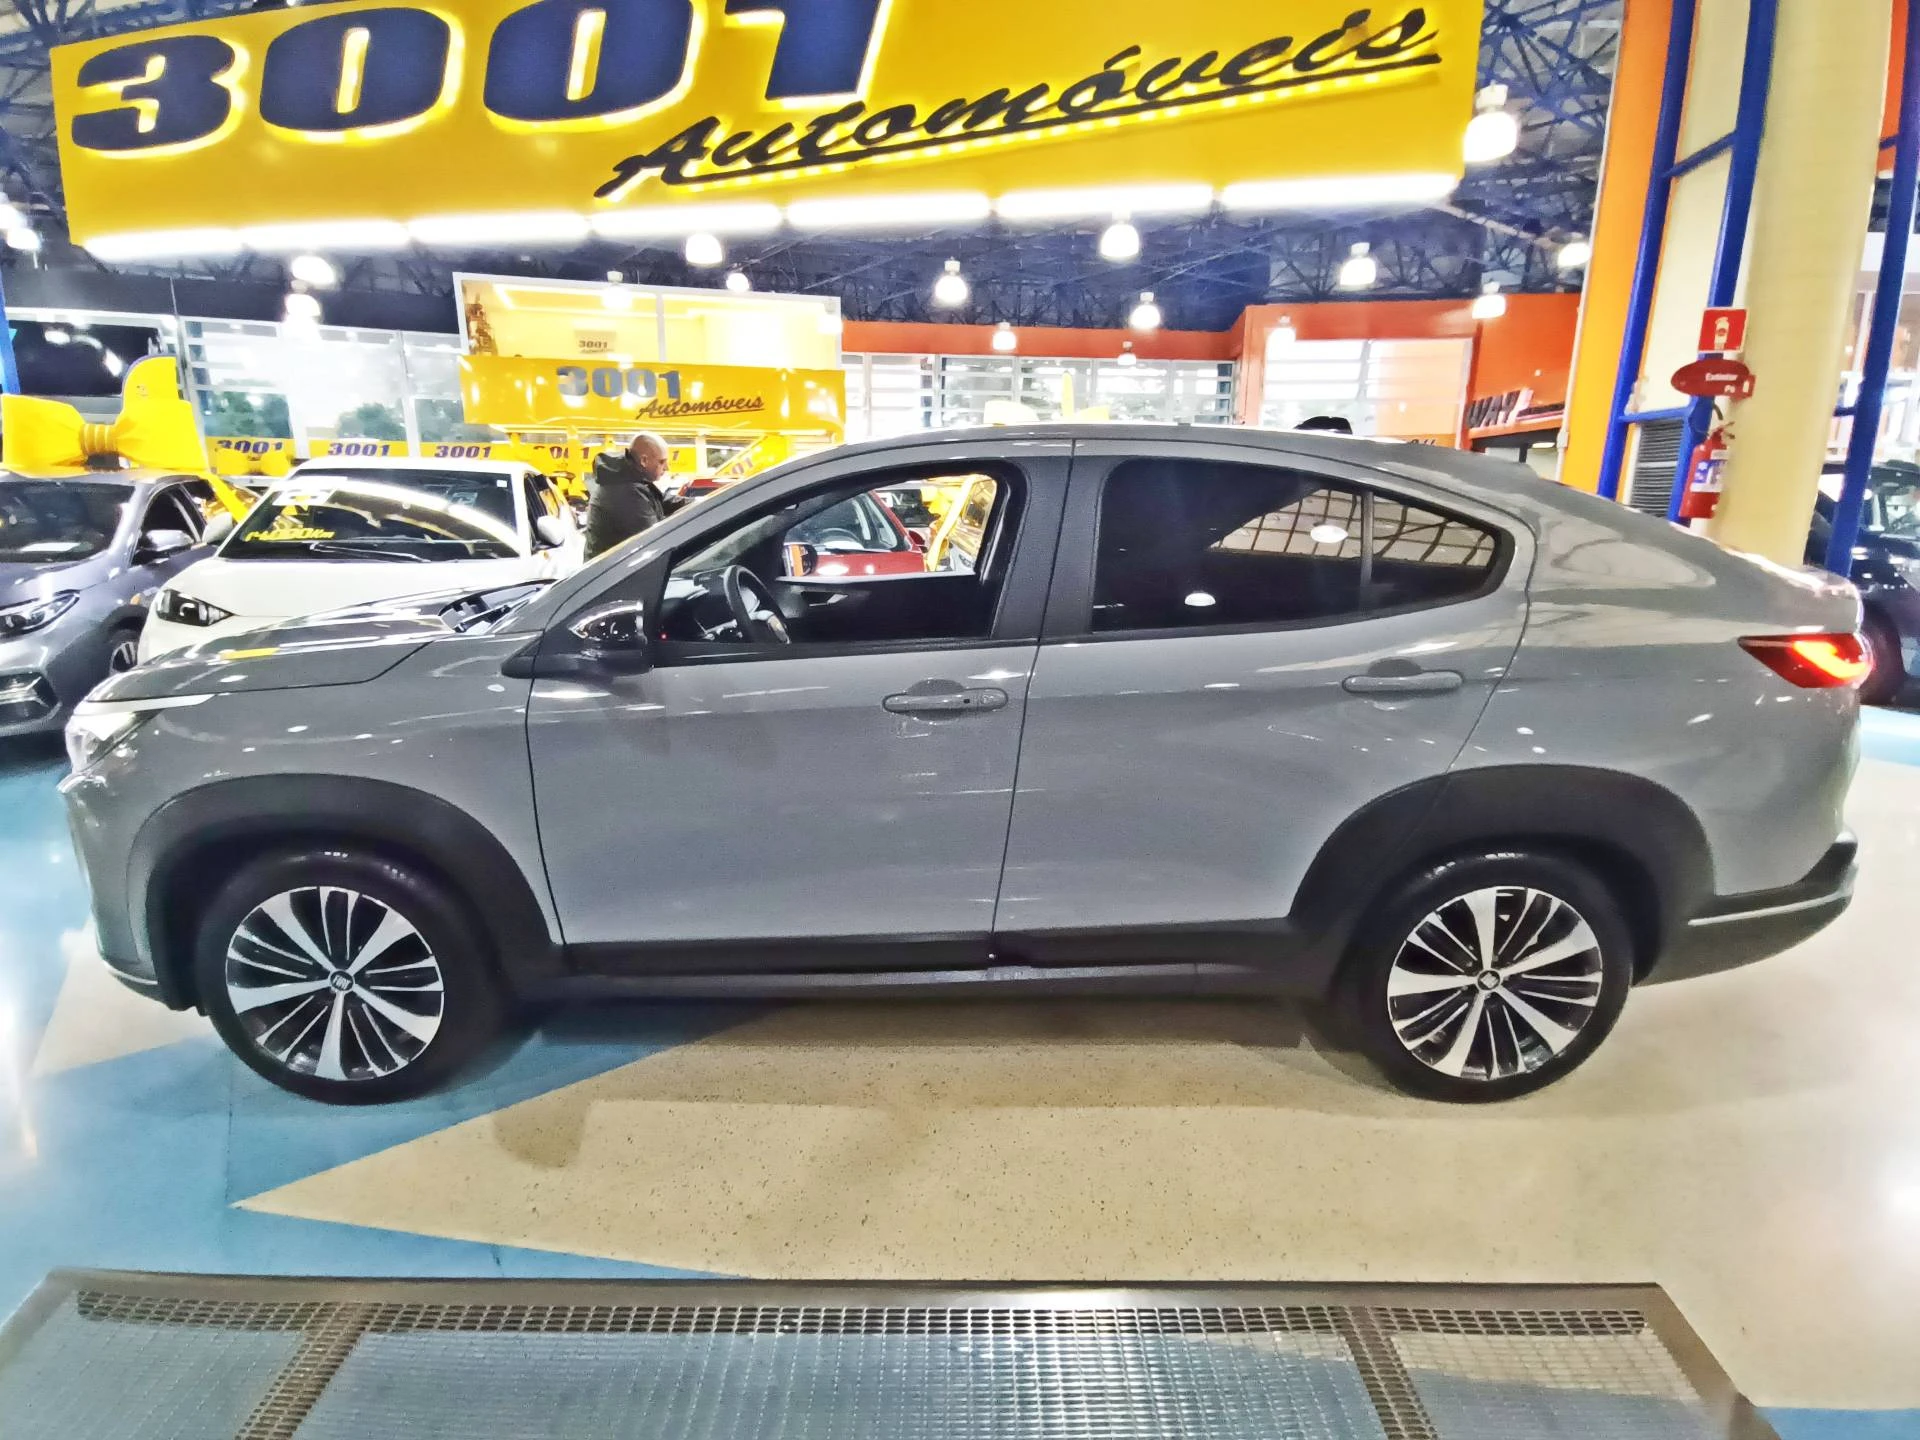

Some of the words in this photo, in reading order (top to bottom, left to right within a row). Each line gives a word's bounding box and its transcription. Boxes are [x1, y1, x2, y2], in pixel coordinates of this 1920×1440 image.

[72, 0, 883, 150] 3001
[594, 8, 1440, 199] Automóveis
[556, 366, 681, 400] 3001
[635, 396, 765, 420] Automóveis
[327, 442, 391, 456] 3001
[434, 445, 492, 458] 3001
